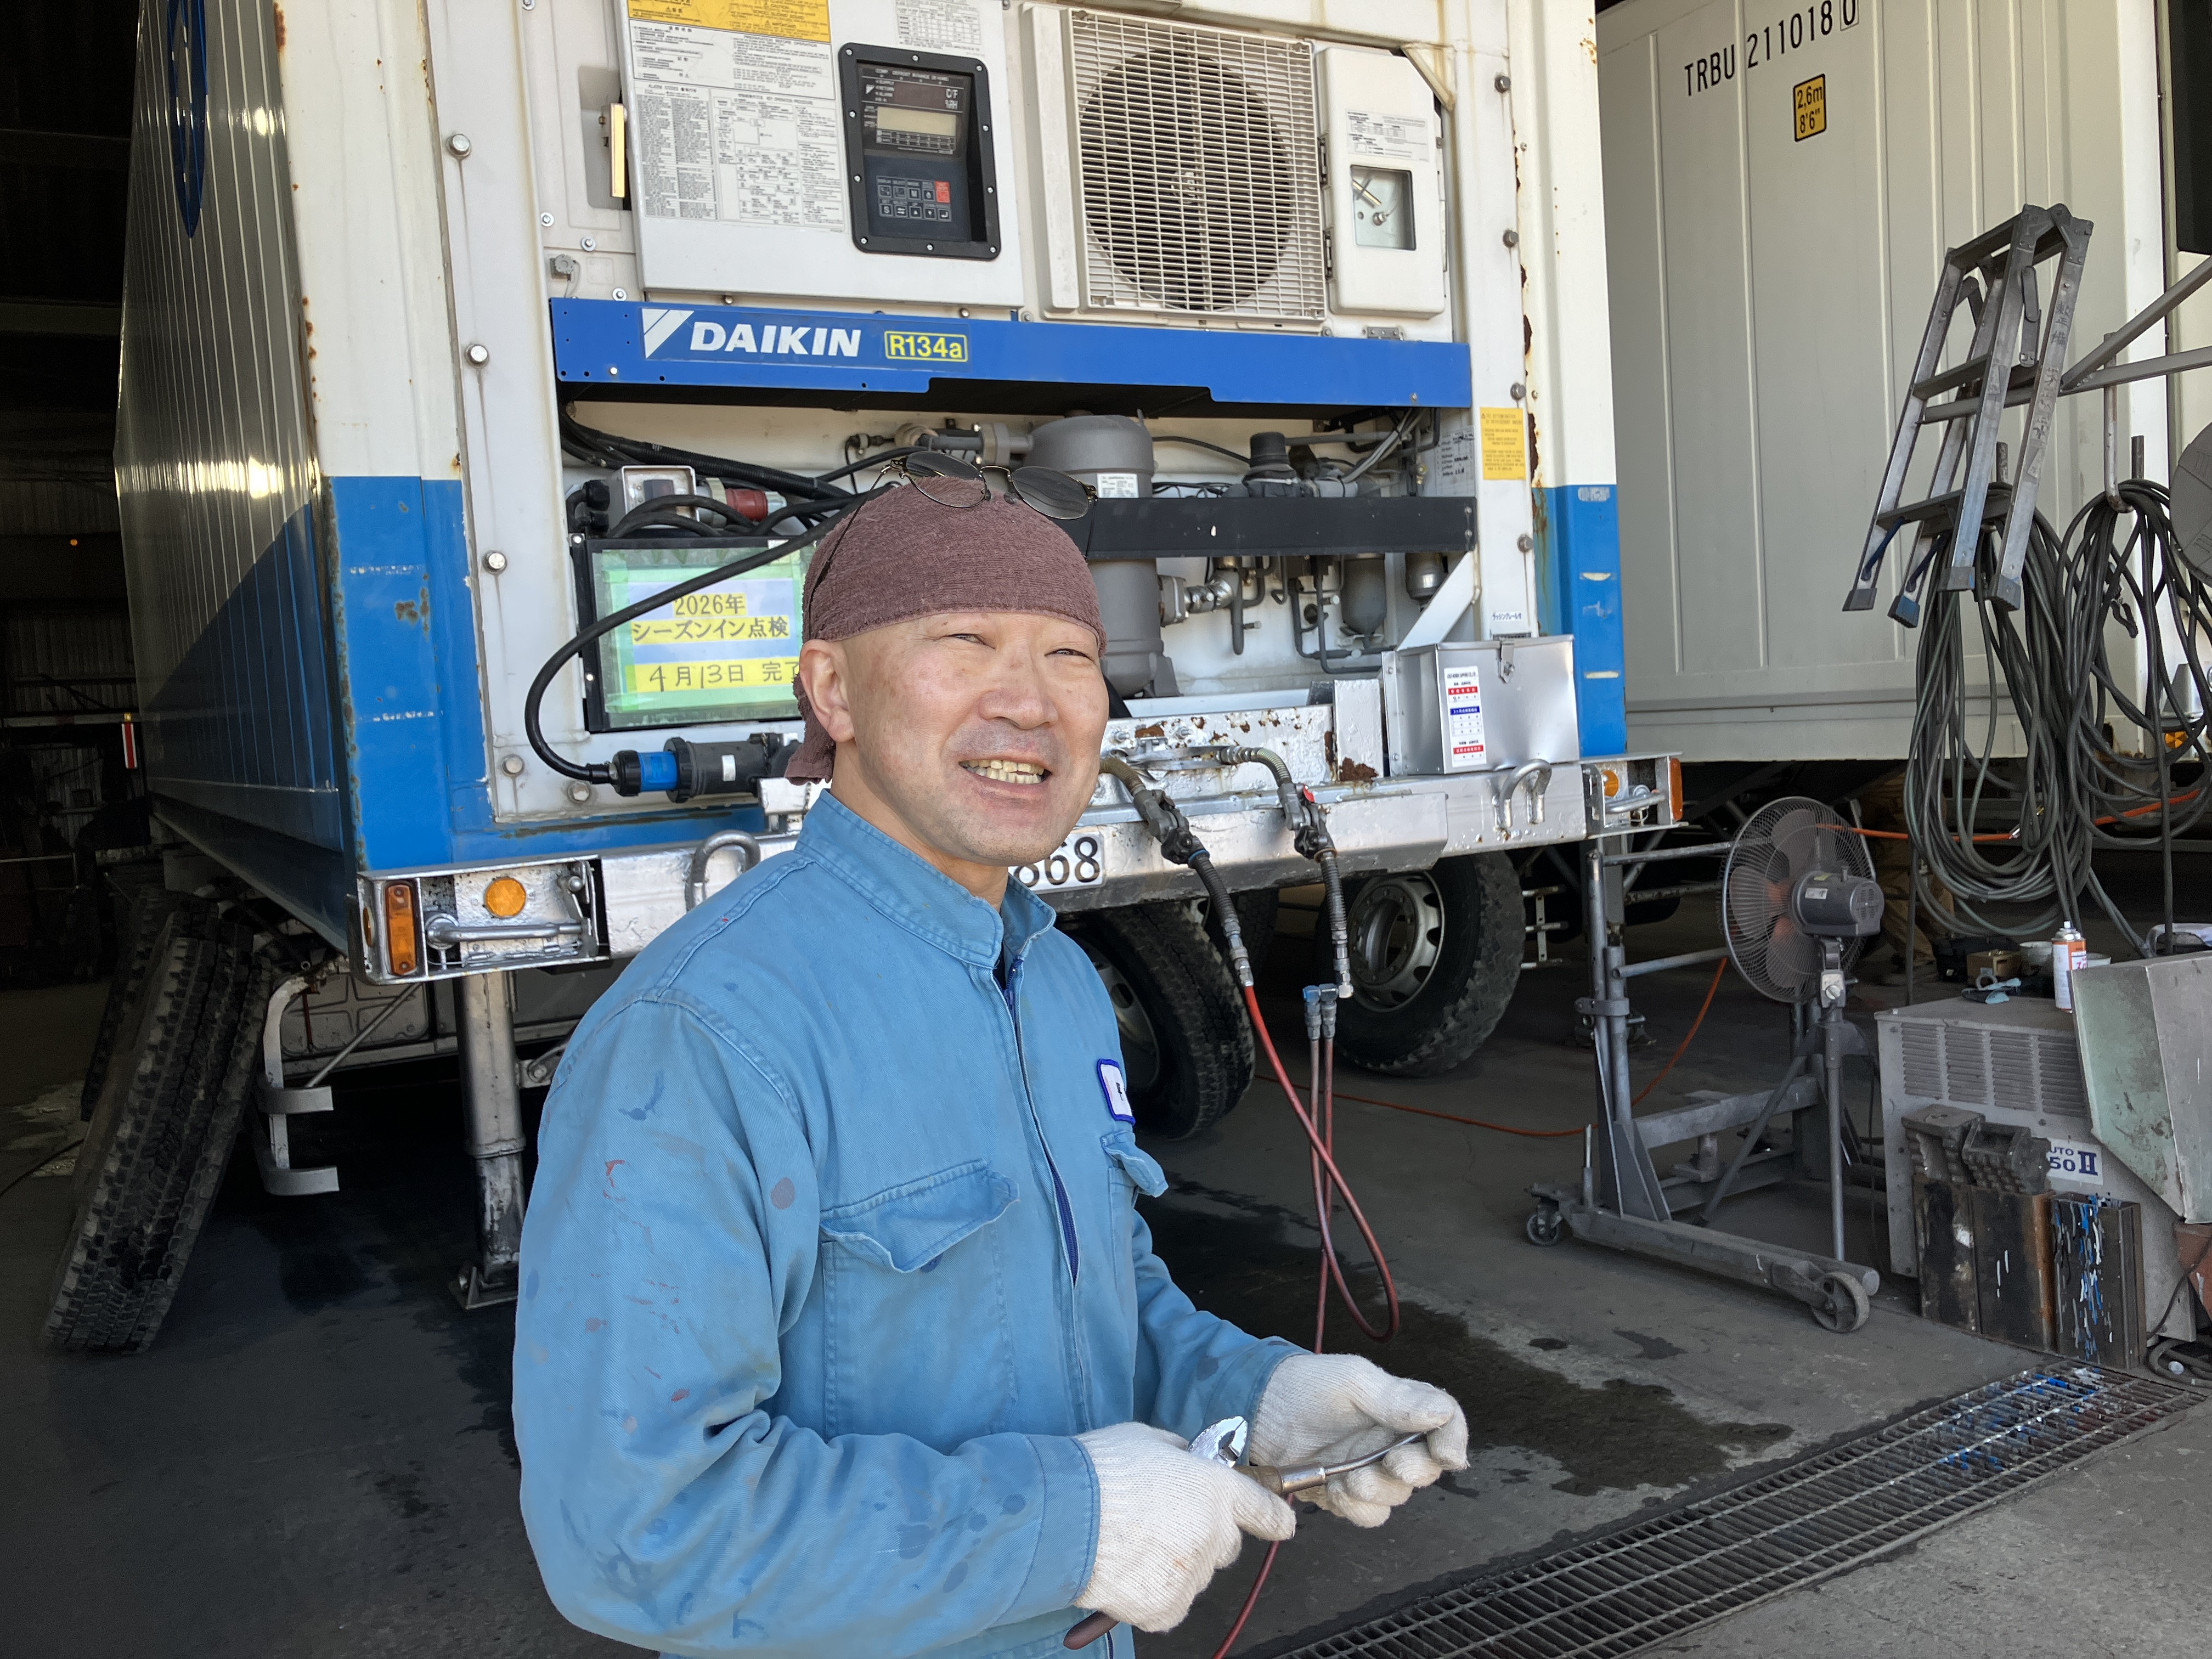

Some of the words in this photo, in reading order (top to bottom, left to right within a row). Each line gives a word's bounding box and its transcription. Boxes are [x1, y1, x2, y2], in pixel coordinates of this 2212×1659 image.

[1684, 44, 1735, 97] TRBU
[1747, 0, 1833, 69] 211018
[1797, 86, 1824, 110] 2,6m
[1799, 108, 1821, 134] 8'6"
[690, 321, 861, 358] DAIKIN
[889, 335, 963, 359] R134a
[674, 594, 746, 617] 2026年
[633, 617, 789, 642] シーズンイン点検
[650, 664, 744, 692] 4月13日
